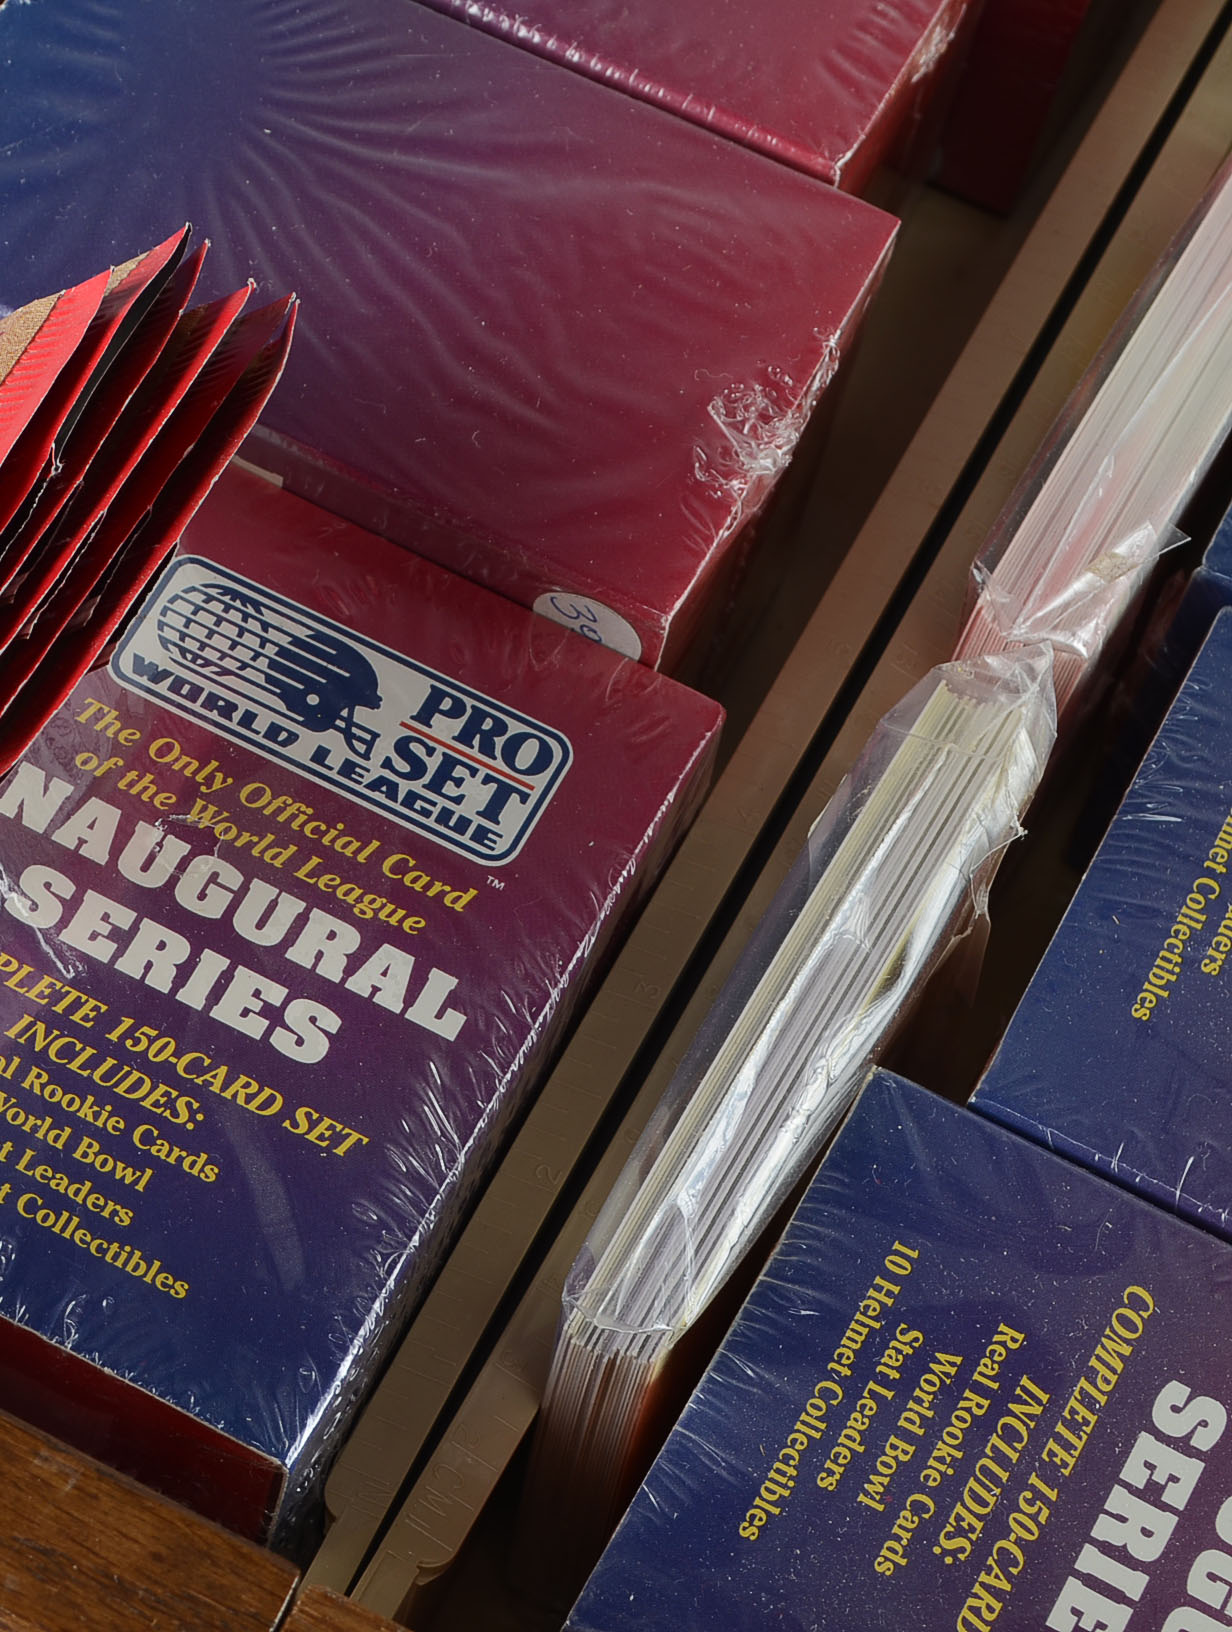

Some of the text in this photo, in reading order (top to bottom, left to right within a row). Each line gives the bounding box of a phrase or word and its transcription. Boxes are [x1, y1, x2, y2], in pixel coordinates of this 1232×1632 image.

[77, 698, 479, 912] The Only Official Card
[132, 652, 504, 852] WORLD LEAGUE
[380, 735, 532, 826] SET
[409, 684, 554, 777] PRO
[75, 751, 427, 934] of the World League
[4, 864, 343, 1066] SERIES
[1131, 877, 1221, 1021] Collectibles
[4, 1013, 205, 1131] INCLUDES:
[21, 1065, 125, 1136] Rookie
[132, 1124, 220, 1183] Cards
[106, 1016, 284, 1116] 150-CARD
[282, 1106, 370, 1158] SET
[15, 1148, 134, 1227] Leaders
[71, 1135, 154, 1192] Bowl
[16, 1193, 191, 1300] Collectibles
[739, 1240, 920, 1541] 10 Helmet Collectibles
[817, 1323, 924, 1491] Stat Leaders
[857, 1352, 964, 1512] World Bowl
[874, 1322, 1026, 1577] Real Rookie Cards
[1041, 1285, 1155, 1477] COMPLETE
[933, 1374, 1051, 1565] INCLUDES:
[1045, 1380, 1228, 1632] SERIE
